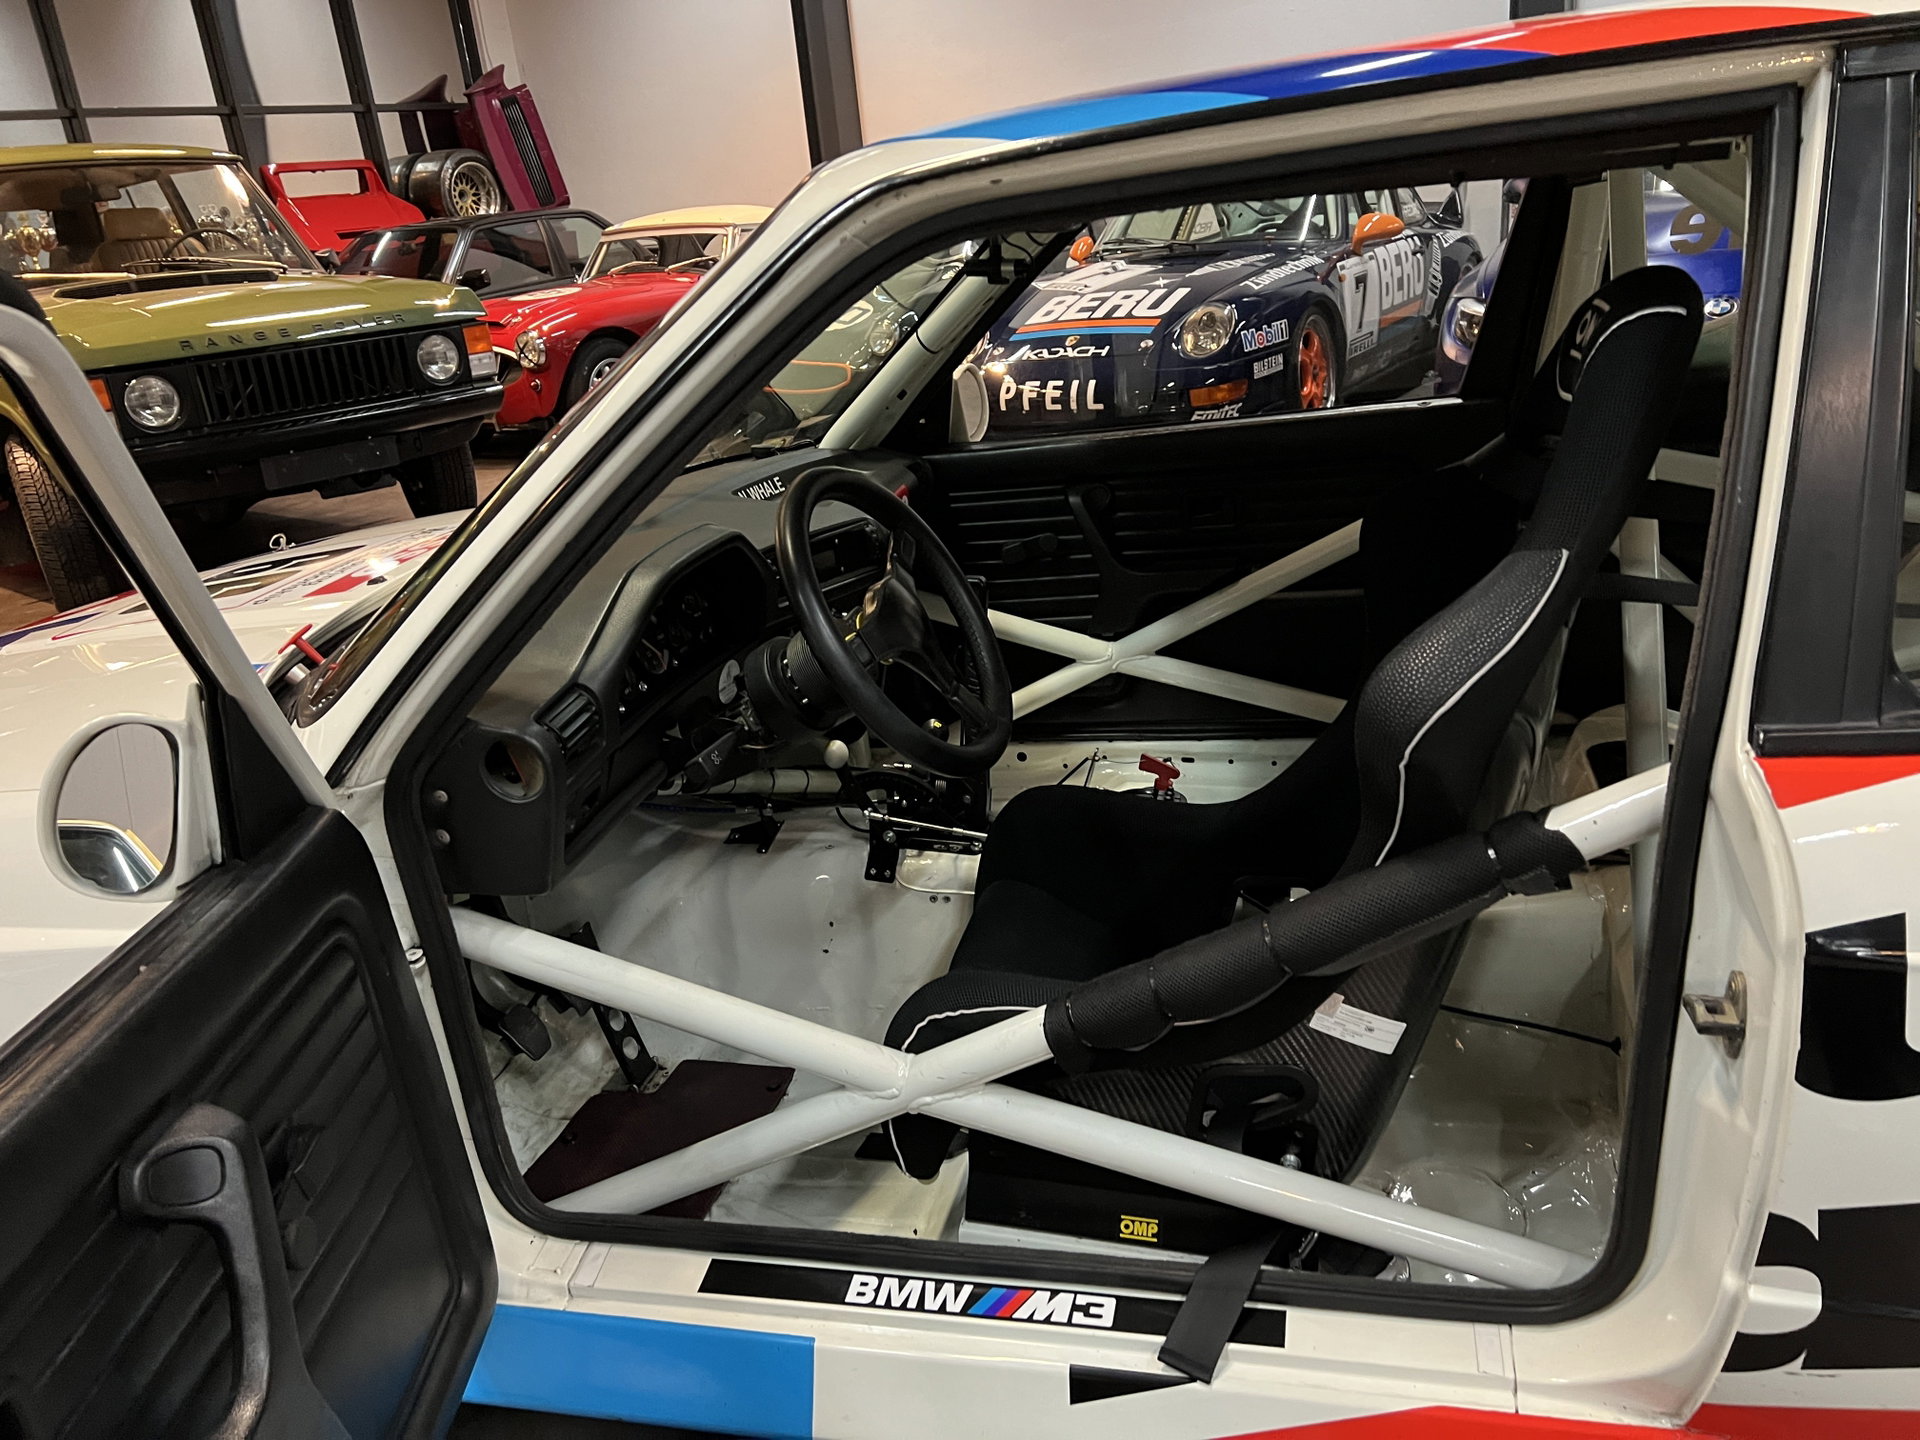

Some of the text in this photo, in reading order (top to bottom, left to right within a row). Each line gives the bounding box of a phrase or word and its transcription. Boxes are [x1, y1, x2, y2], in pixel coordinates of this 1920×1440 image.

[1374, 236, 1424, 310] BERU
[1025, 288, 1191, 325] BERU
[1353, 270, 1369, 333] 7
[179, 313, 407, 352] RANGE ROVER
[1253, 353, 1283, 372] BILSTEIN
[999, 375, 1104, 411] PFEIL
[746, 476, 786, 500] WHALE
[1120, 1218, 1159, 1238] OMP
[844, 1273, 1117, 1328] BMW M3
